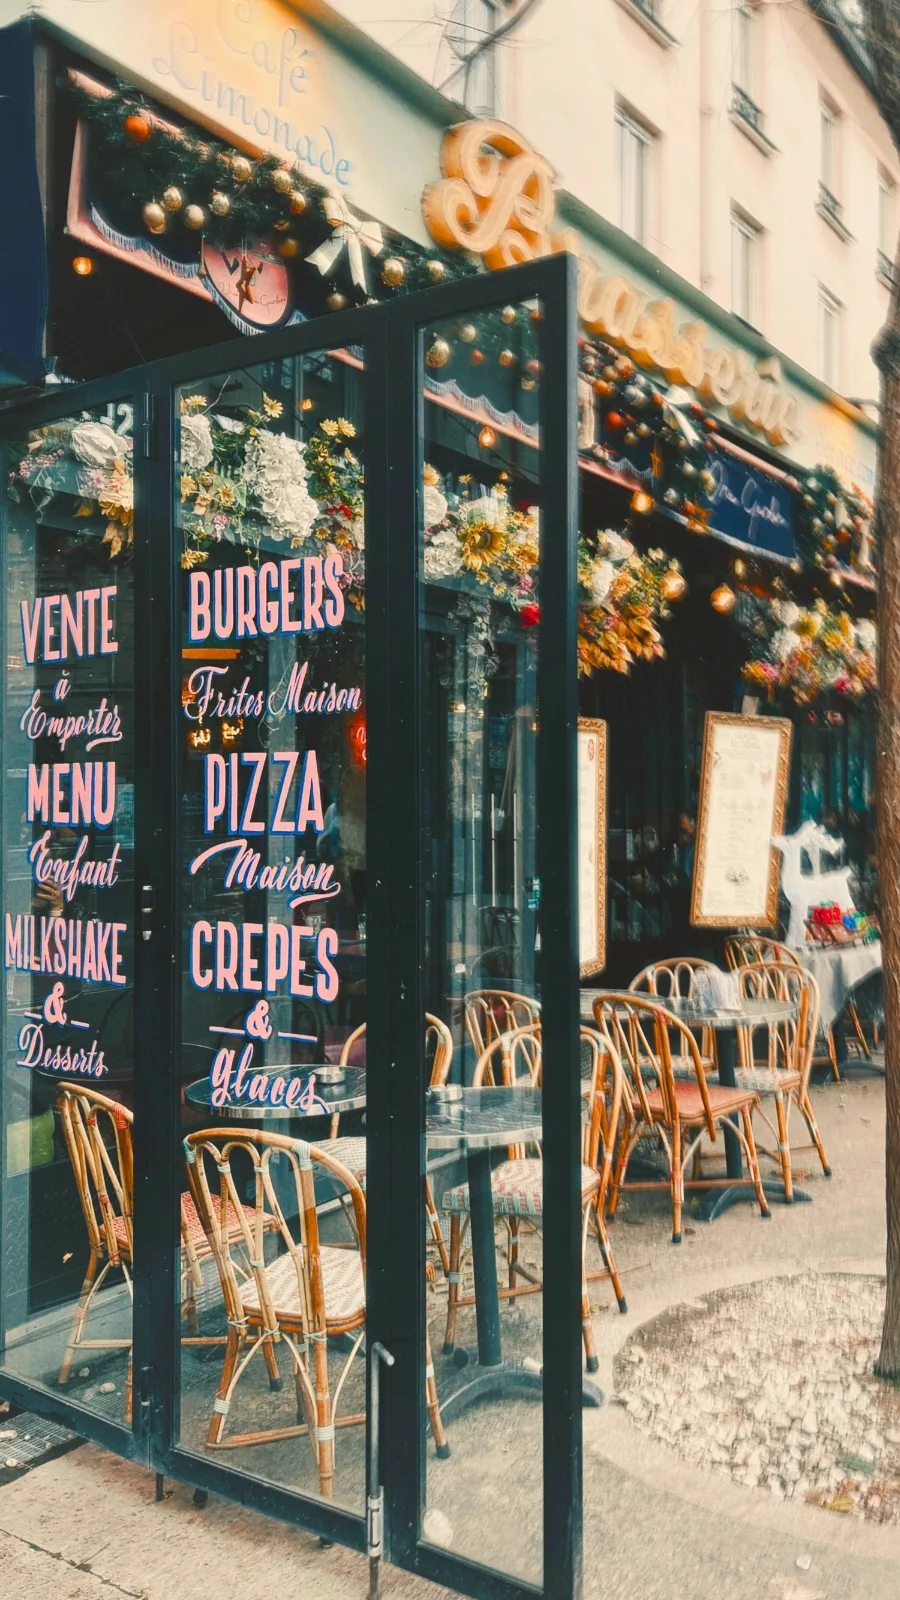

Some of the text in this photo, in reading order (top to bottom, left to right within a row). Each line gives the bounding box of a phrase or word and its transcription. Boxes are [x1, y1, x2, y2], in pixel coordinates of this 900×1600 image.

[151, 21, 351, 185] Limonade
[19, 585, 118, 666] VENTE
[188, 552, 346, 643] BURGERS
[19, 688, 123, 752] Emporter
[184, 661, 362, 720] Frites Maison
[27, 761, 116, 829] MENU
[203, 750, 324, 835] PIZZA
[29, 830, 122, 901] Enfant
[190, 838, 341, 909] Maison
[5, 912, 127, 987] MILKSHAKE
[189, 920, 340, 1003] CREPES
[42, 981, 68, 1026] &
[245, 1000, 272, 1042] &
[16, 1023, 109, 1078] Desserts
